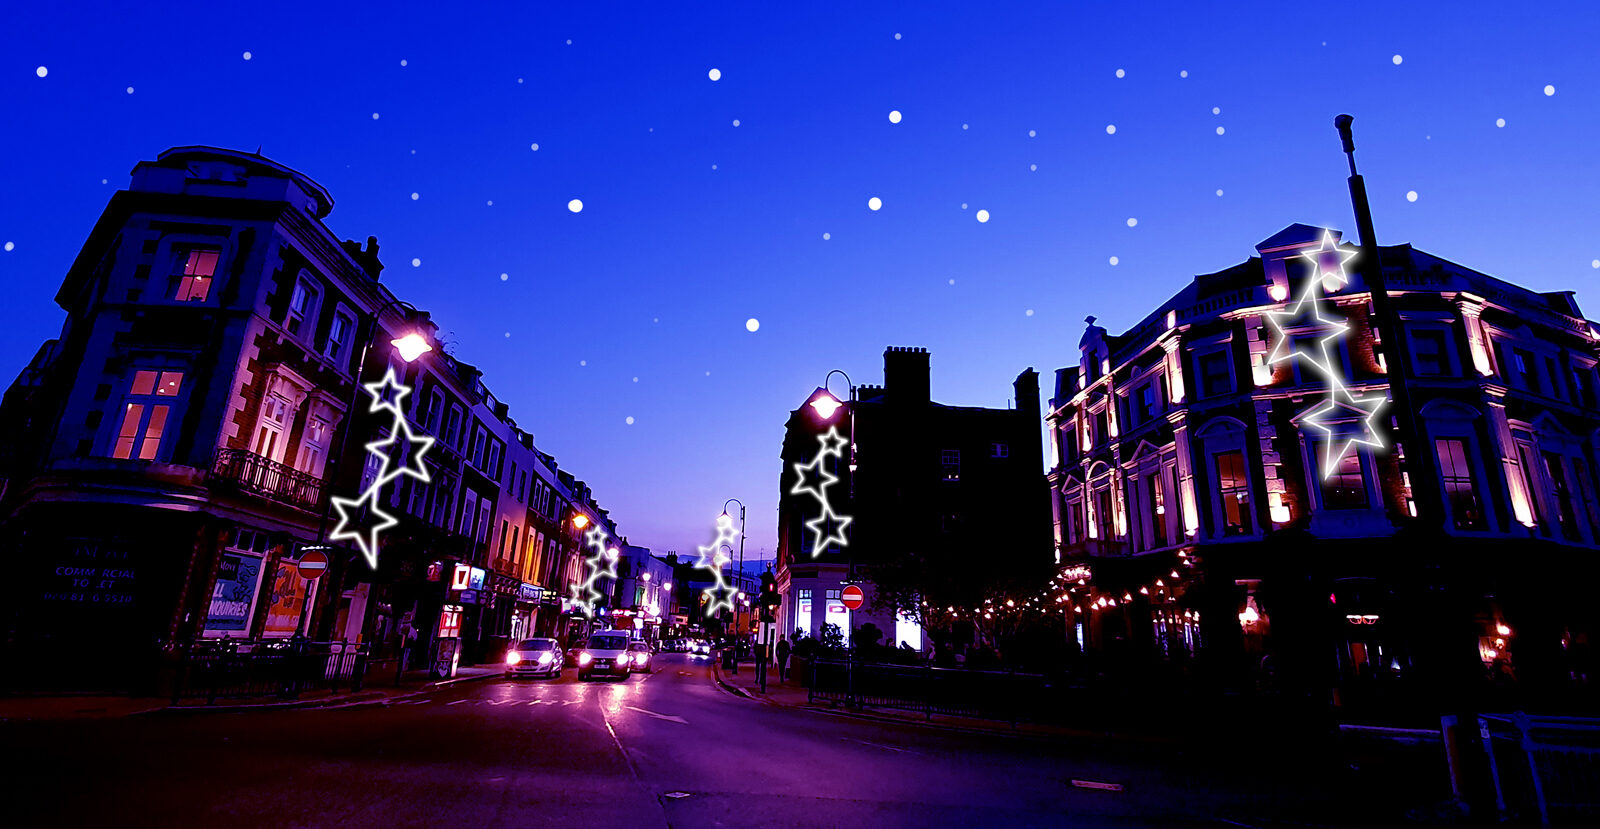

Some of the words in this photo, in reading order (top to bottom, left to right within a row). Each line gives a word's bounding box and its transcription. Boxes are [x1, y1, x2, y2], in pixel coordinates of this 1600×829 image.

[55, 566, 135, 579] COMMRCIAL
[72, 578, 90, 588] TO
[207, 599, 249, 617] NQUIRIES
